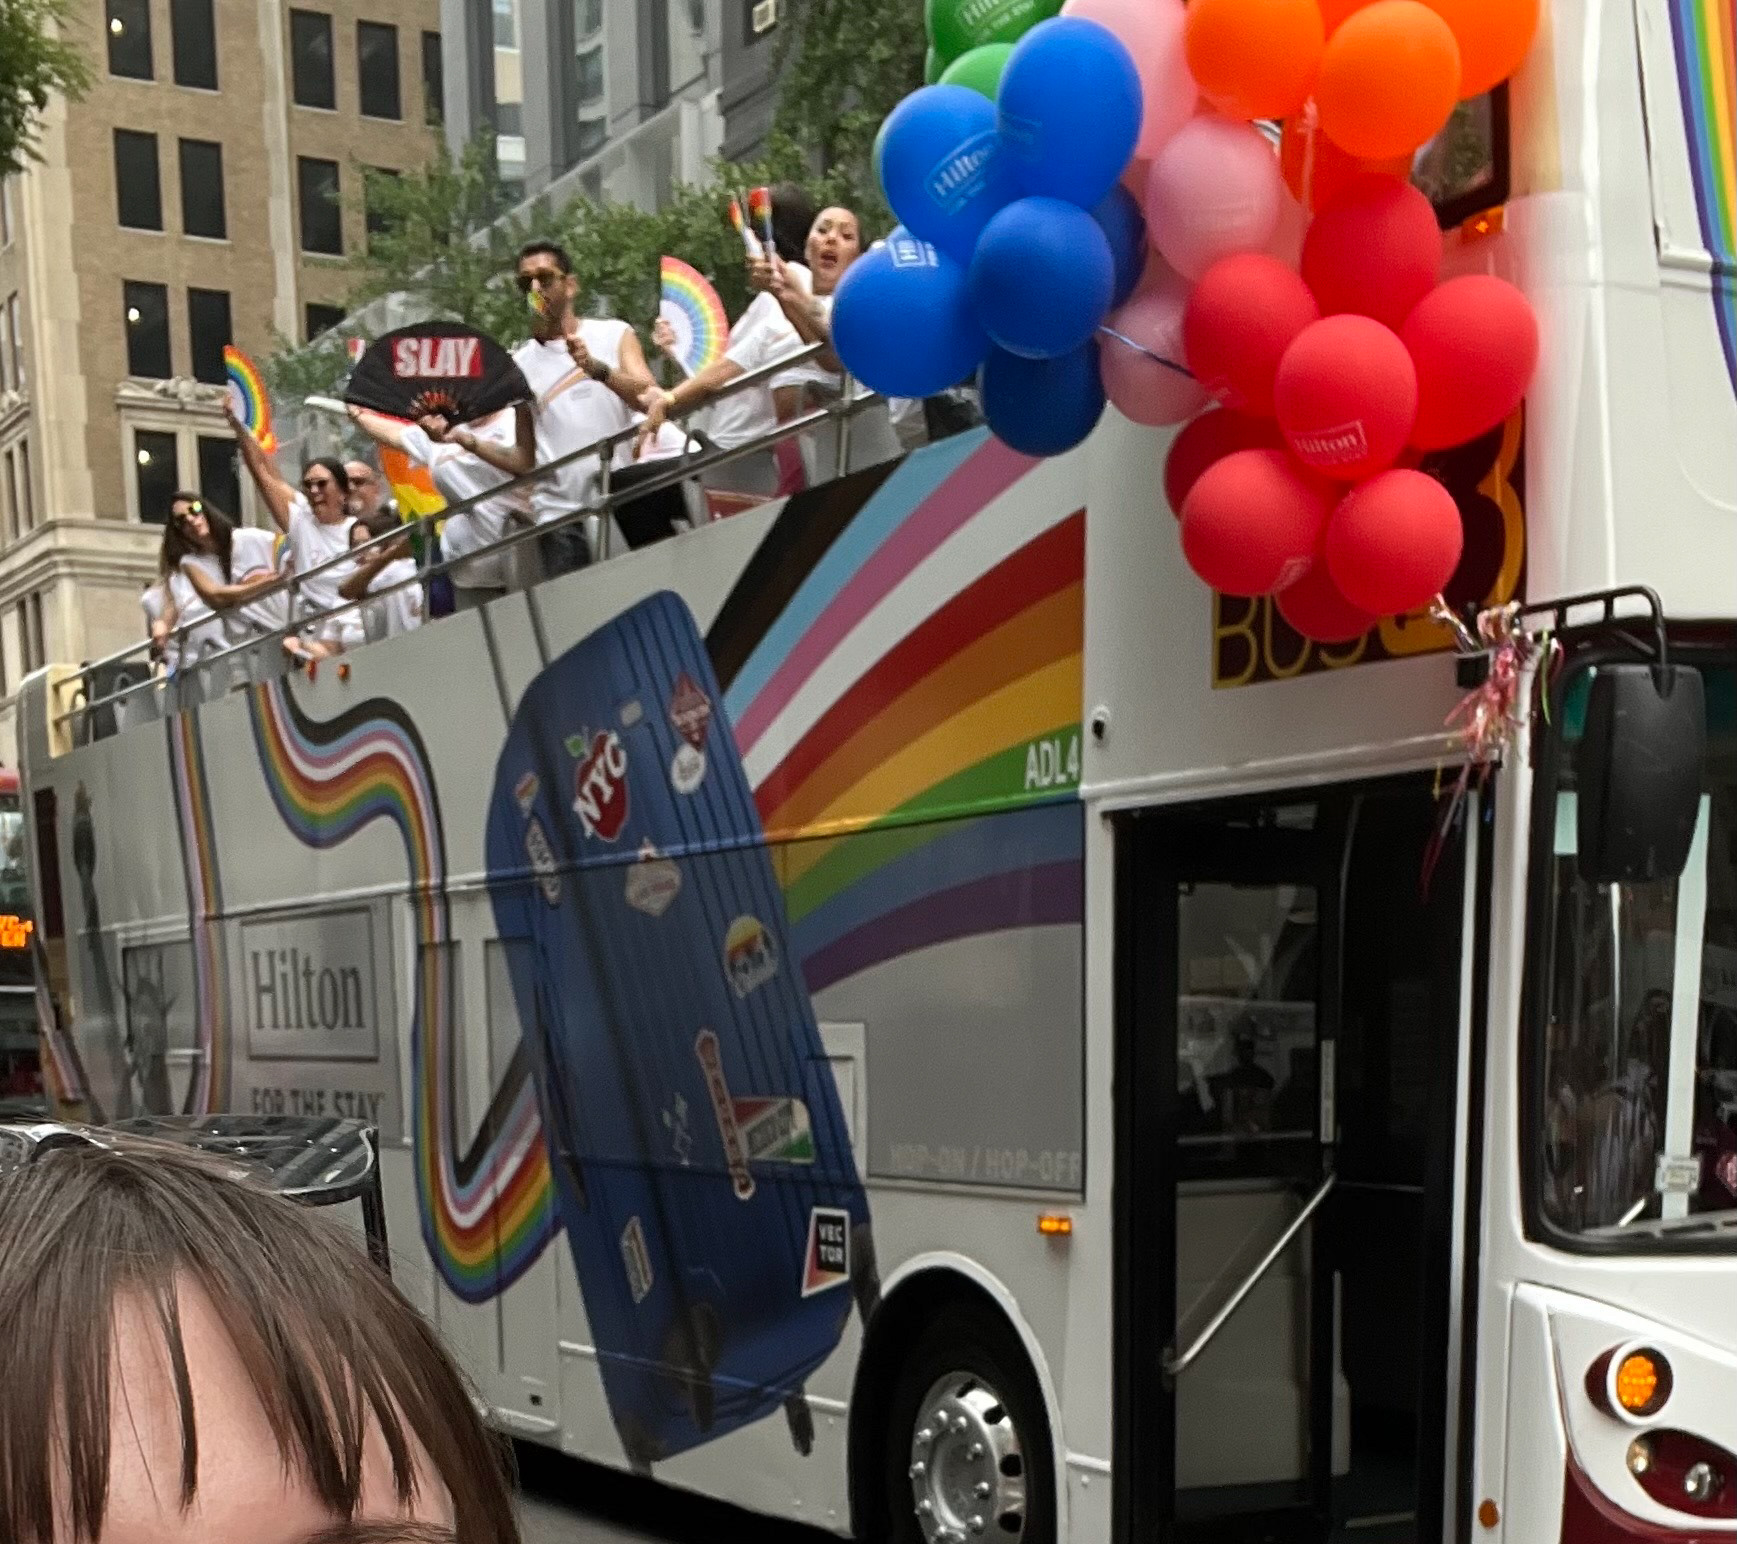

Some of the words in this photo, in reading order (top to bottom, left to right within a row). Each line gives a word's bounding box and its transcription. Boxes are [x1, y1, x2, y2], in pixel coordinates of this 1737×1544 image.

[933, 143, 997, 197] Hilton
[394, 337, 479, 377] SLAY
[1294, 432, 1358, 453] Hilton
[1212, 593, 1369, 689] BU
[572, 730, 628, 838] NYC
[1024, 736, 1080, 790] ADL4
[252, 948, 366, 1030] Hilton
[252, 1087, 285, 1115] FOR
[290, 1088, 325, 1117] THE
[333, 1089, 379, 1124] STAY
[818, 1222, 843, 1243] VEC
[819, 1244, 843, 1264] TOR
